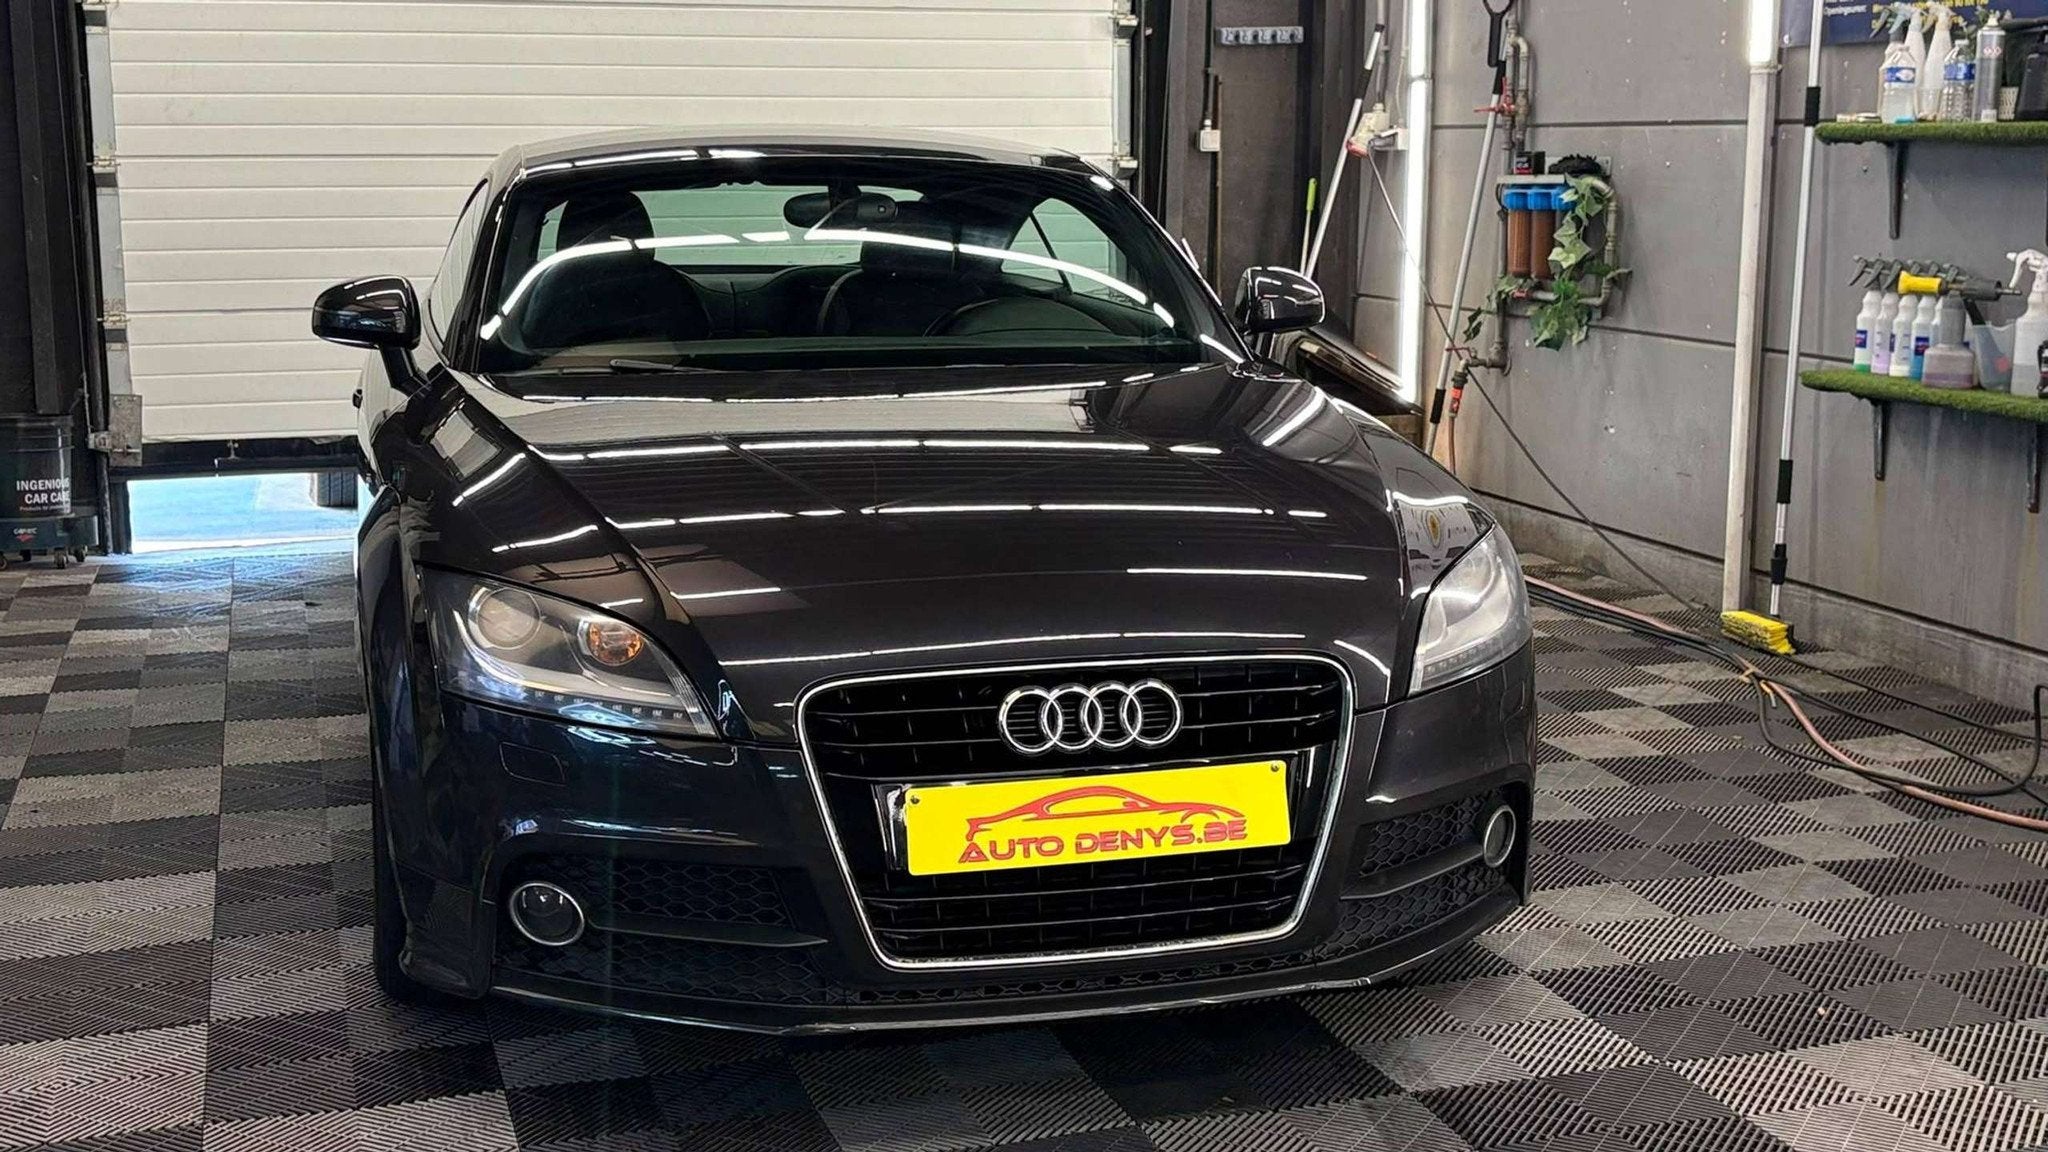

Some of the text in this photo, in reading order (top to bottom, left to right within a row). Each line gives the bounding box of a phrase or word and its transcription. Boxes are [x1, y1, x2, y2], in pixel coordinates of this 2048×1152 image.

[24, 493, 48, 504] CAR
[958, 819, 1247, 863] AUTO DENYS.BE
